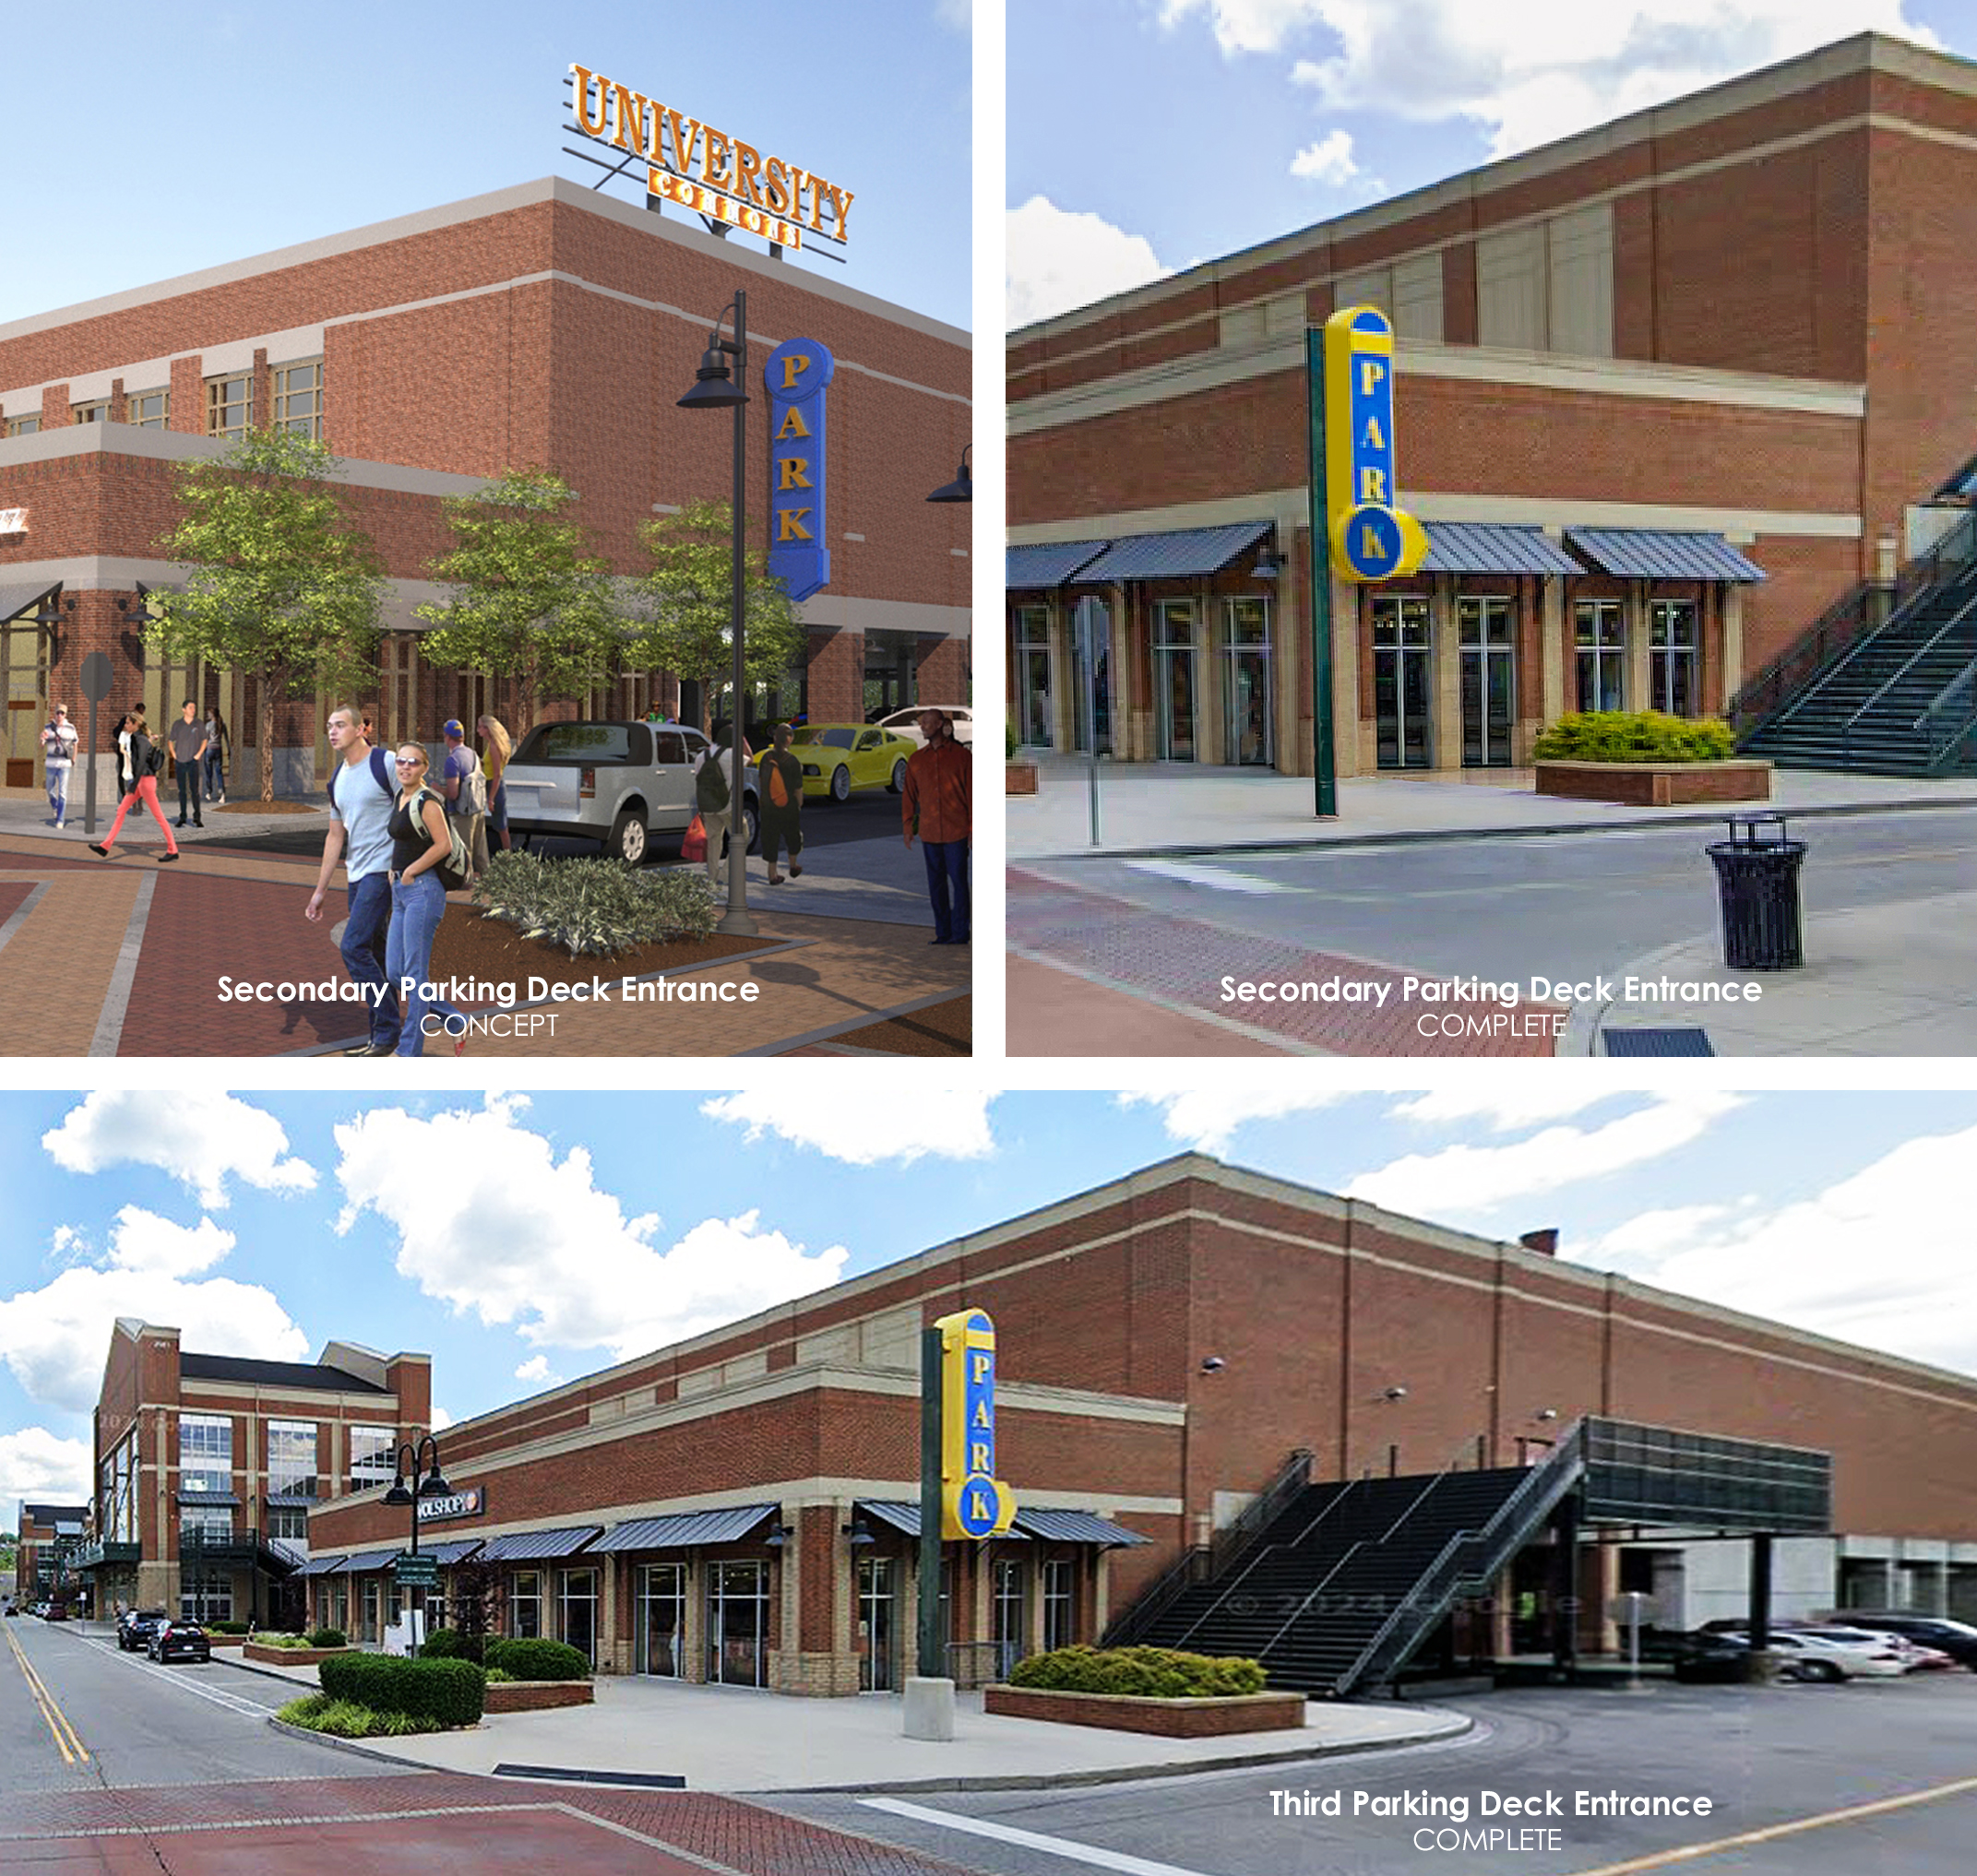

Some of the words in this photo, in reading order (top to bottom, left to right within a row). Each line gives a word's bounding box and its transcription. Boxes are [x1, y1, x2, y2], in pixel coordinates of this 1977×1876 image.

[569, 64, 855, 243] UNIVERSITY
[659, 173, 797, 247] COMMONS
[774, 354, 815, 541] PARK
[1359, 360, 1387, 559] PARK
[971, 1355, 992, 1522] PARK
